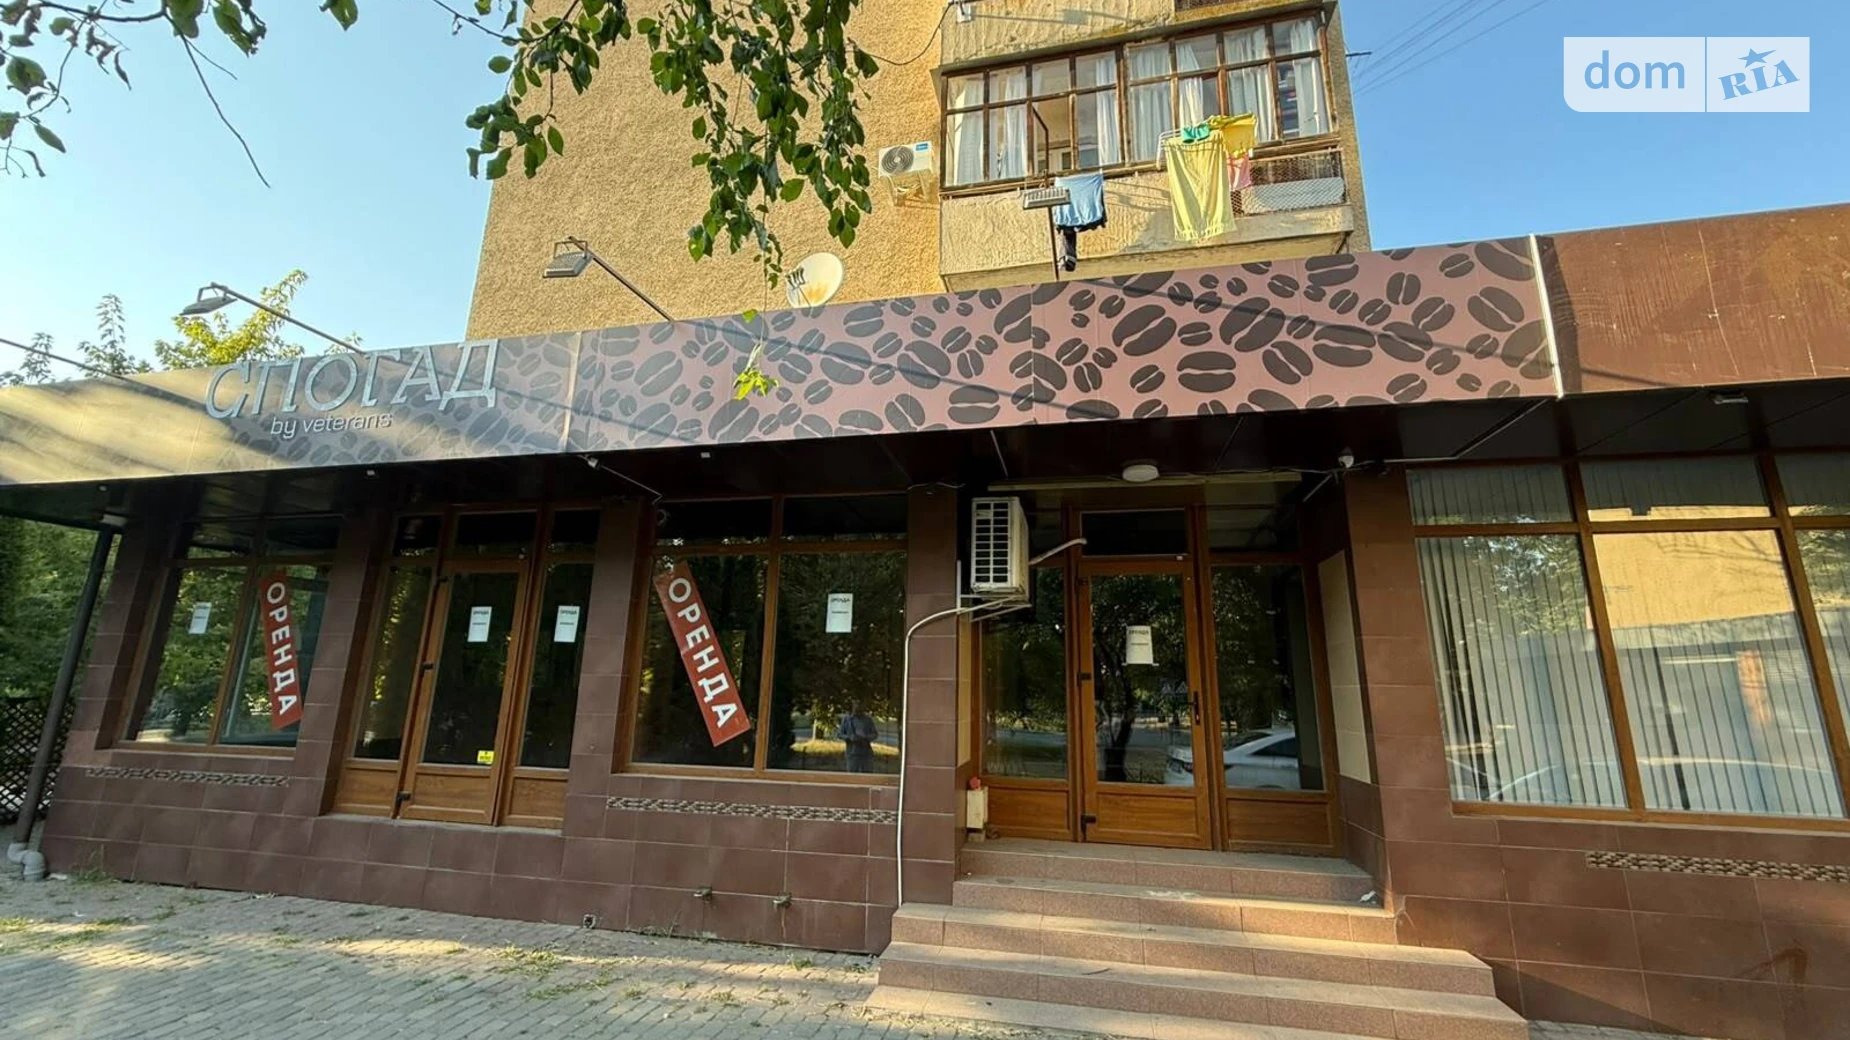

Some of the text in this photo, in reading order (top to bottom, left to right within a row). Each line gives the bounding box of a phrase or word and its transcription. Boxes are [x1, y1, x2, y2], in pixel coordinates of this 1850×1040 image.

[204, 338, 499, 419] СПОГАД
[270, 411, 394, 440] by veterans
[266, 581, 298, 716] ОРЕНДА
[668, 577, 739, 729] ОРЕНДА
